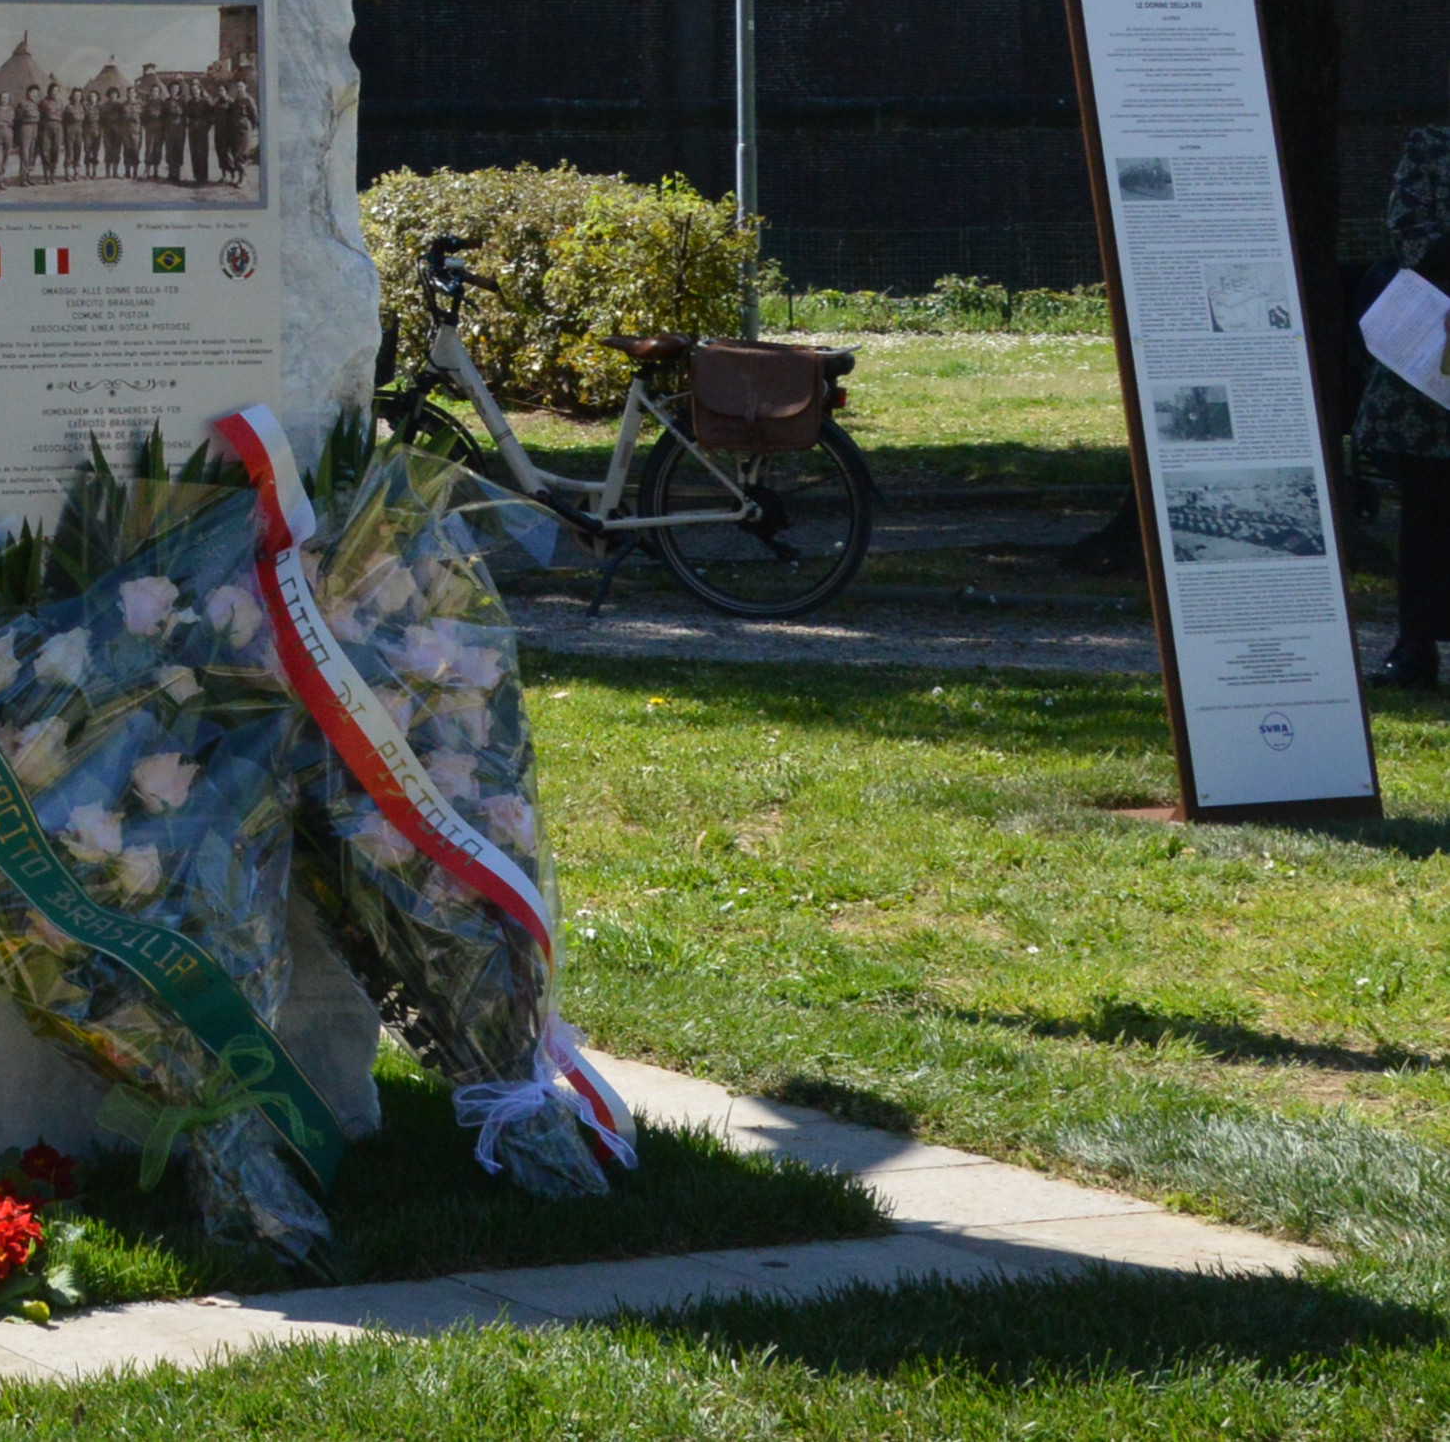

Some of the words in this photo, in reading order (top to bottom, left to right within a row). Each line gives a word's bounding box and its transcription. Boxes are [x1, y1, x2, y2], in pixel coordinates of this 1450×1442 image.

[82, 286, 102, 295] ALLE
[105, 286, 131, 295] DONNE
[135, 286, 161, 295] DELLA
[71, 311, 103, 320] COMUNE
[107, 311, 116, 319] DI
[120, 310, 150, 319] PISTOIA
[30, 324, 87, 333] ASSOCIAZIONE
